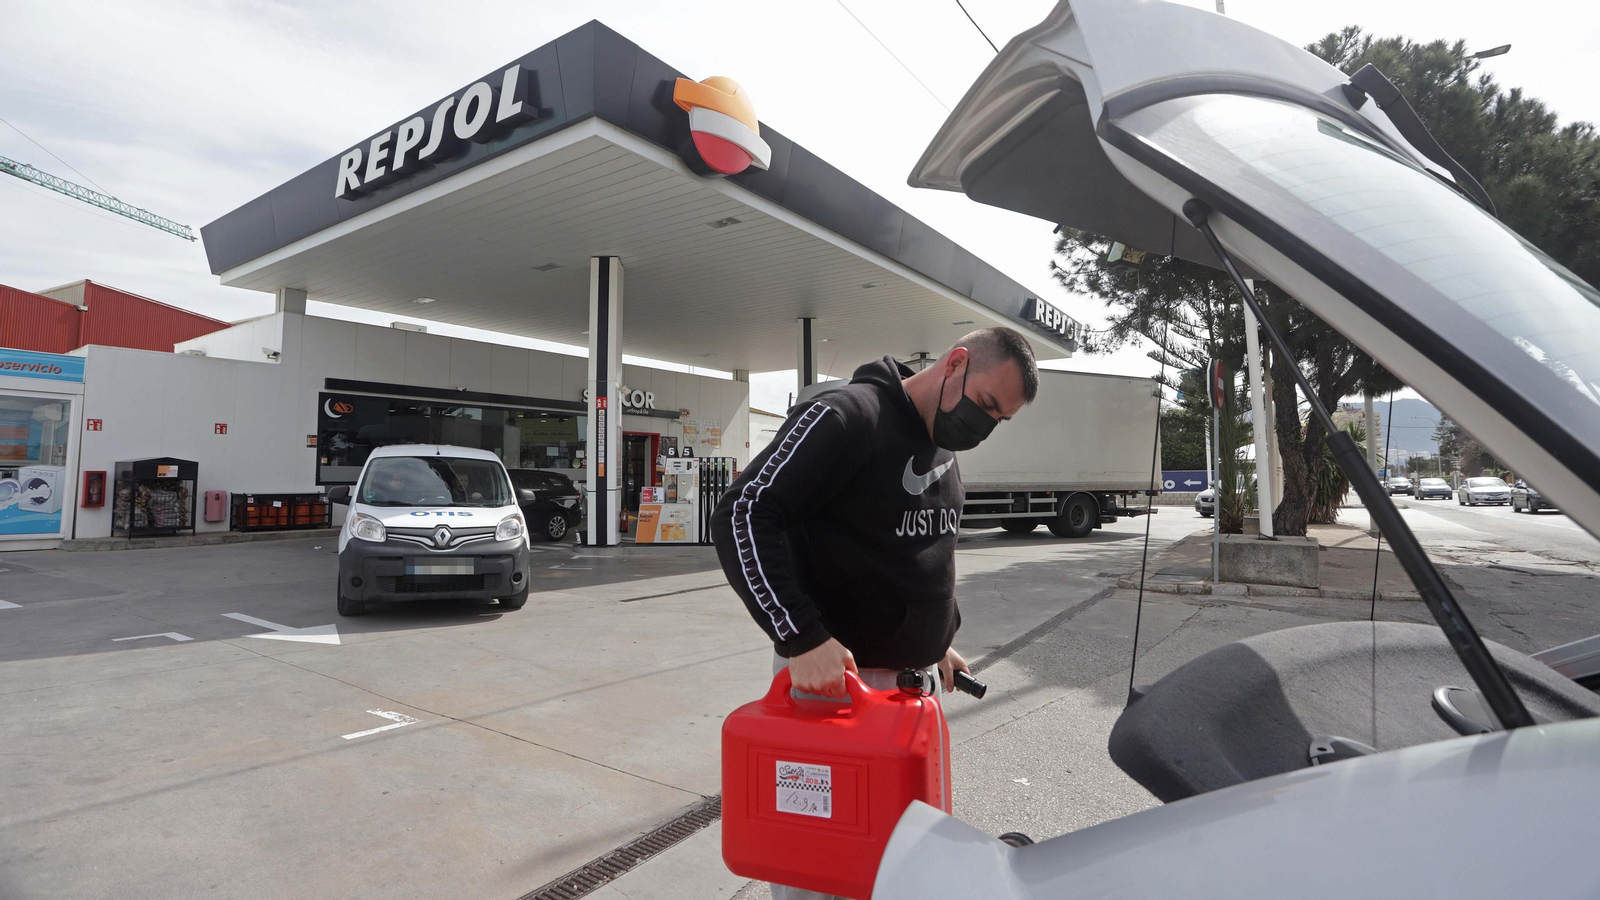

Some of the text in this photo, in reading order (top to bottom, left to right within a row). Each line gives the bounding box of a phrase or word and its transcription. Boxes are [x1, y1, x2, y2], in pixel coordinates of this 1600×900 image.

[335, 64, 524, 198] REPSOL
[1035, 297, 1079, 343] REPSOL
[668, 447, 690, 456] 6 5
[895, 508, 957, 537] JUST DO
